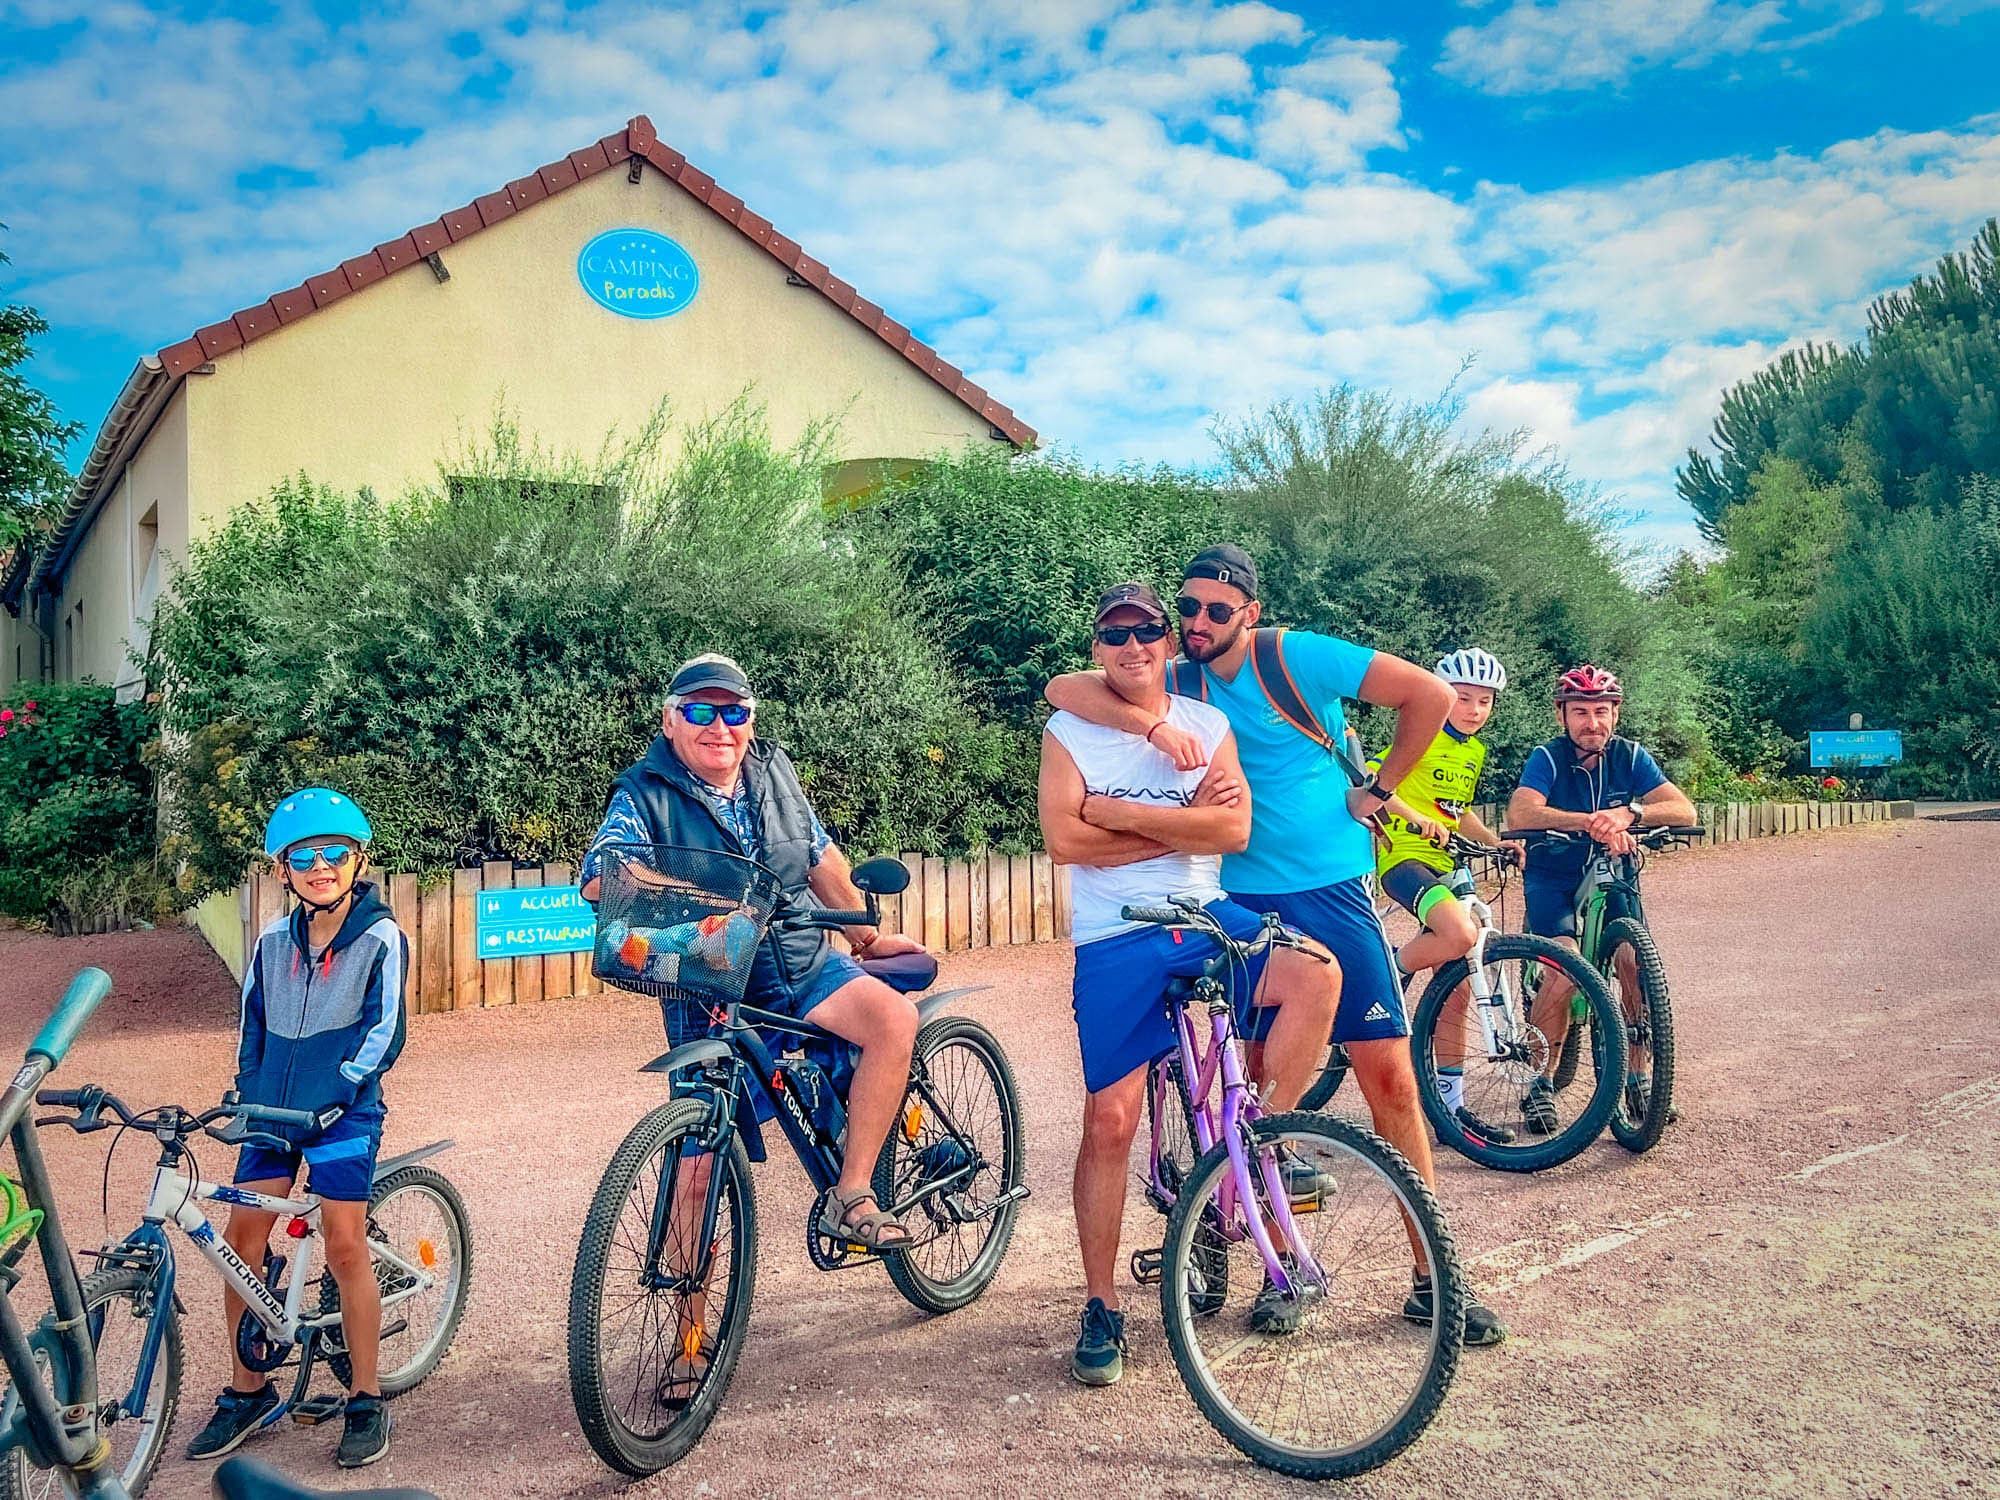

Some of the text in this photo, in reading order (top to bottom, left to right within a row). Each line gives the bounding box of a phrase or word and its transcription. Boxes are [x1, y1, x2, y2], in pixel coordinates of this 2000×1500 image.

[587, 256, 689, 281] CAMPING
[604, 280, 676, 300] Paradis
[520, 893, 585, 911] ACCUEIL
[1364, 1012, 1391, 1022] adidas
[783, 1086, 817, 1147] TOPLIFE
[217, 1245, 289, 1325] ROCKRIDER
